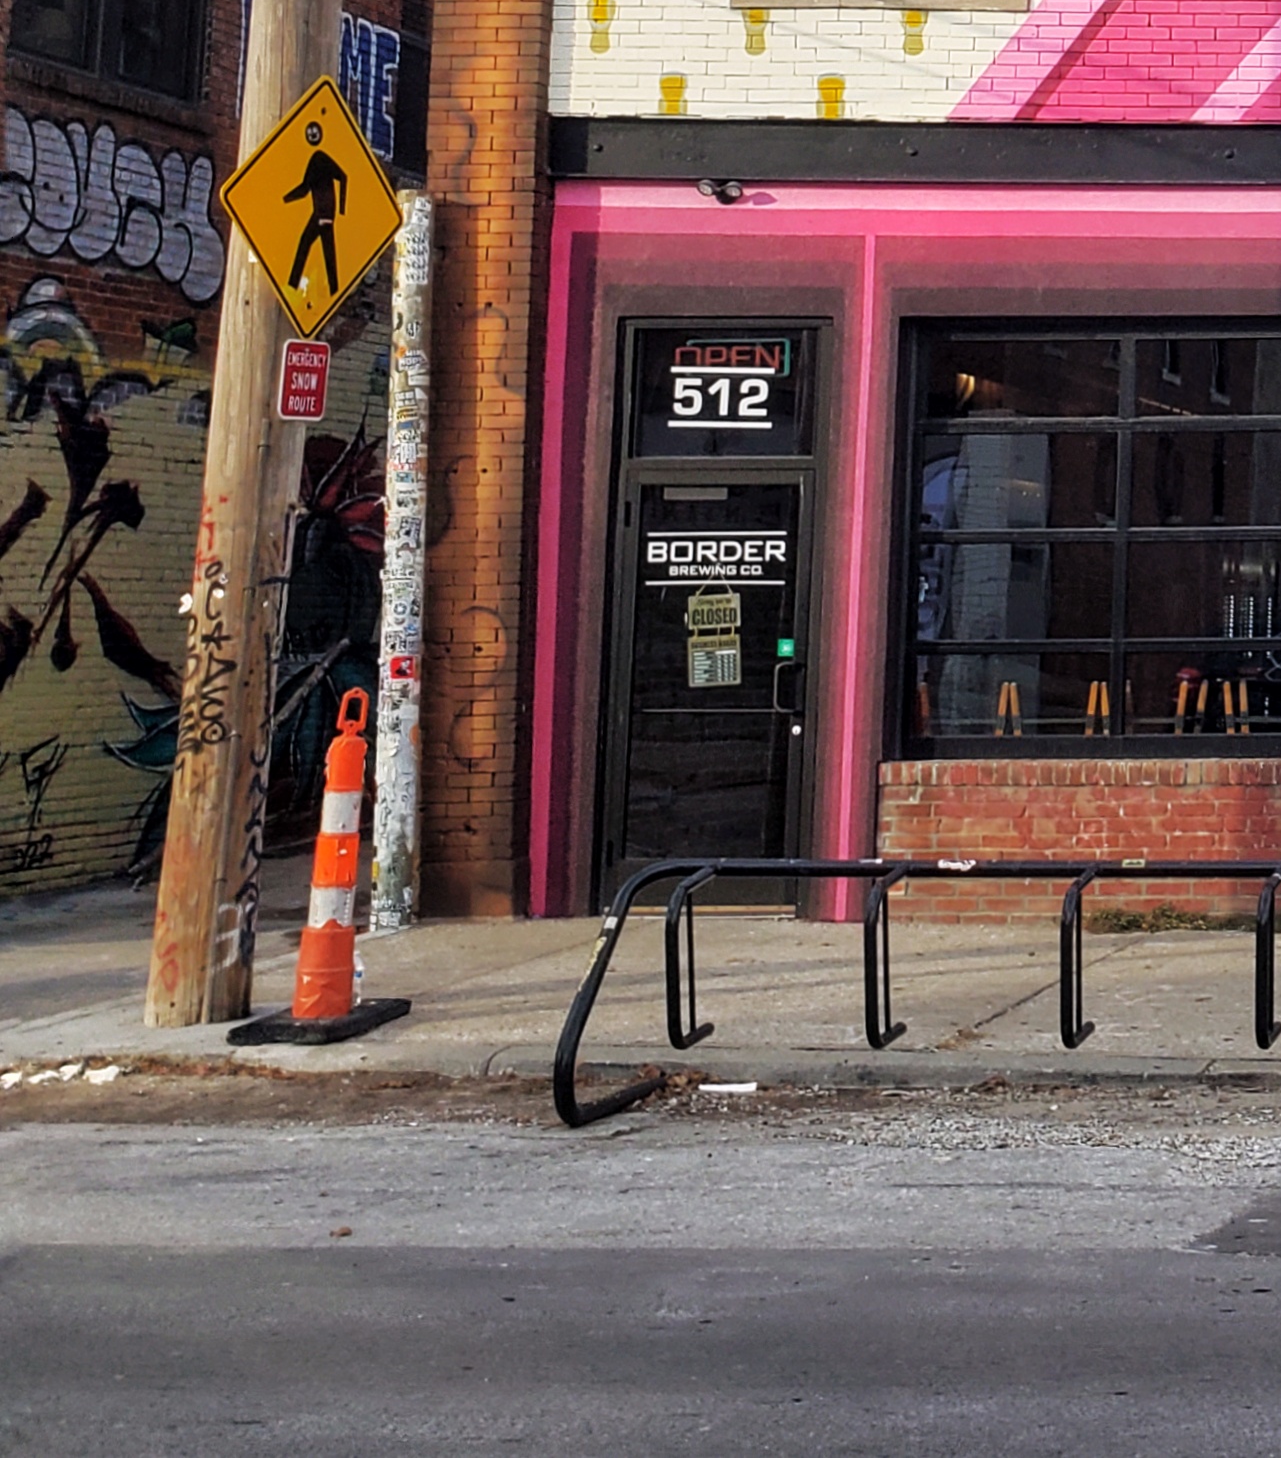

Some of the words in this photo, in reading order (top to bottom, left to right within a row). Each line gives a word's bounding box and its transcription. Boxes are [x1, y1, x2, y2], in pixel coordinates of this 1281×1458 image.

[287, 351, 327, 368] EMERGENCY
[674, 345, 782, 370] OPEN
[291, 371, 319, 390] SNOW
[288, 395, 316, 412] ROUTE
[673, 377, 769, 416] 512
[647, 540, 787, 563] BORDER
[668, 564, 737, 577] BREWING
[692, 607, 738, 626] CLOSED
